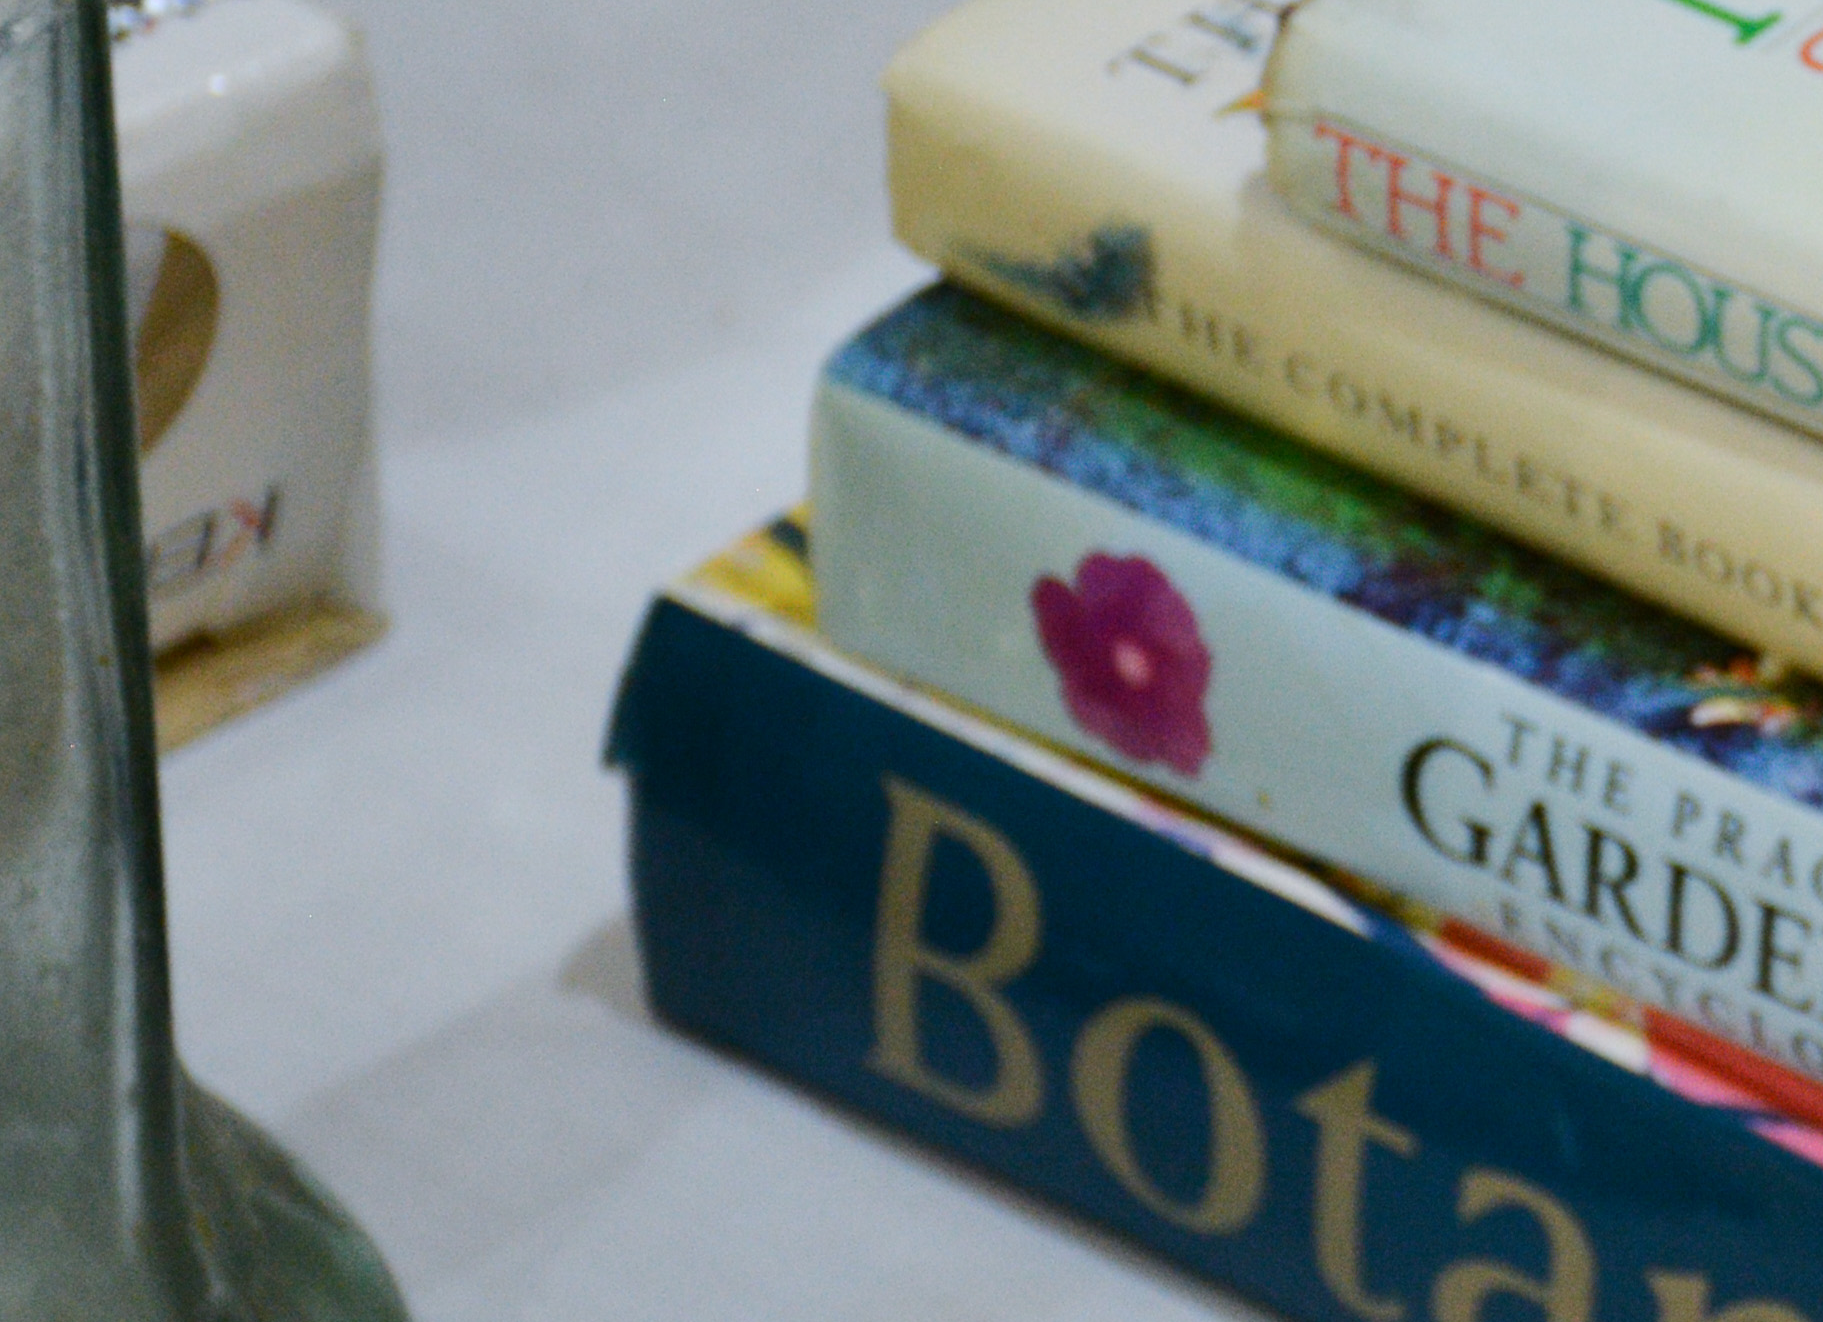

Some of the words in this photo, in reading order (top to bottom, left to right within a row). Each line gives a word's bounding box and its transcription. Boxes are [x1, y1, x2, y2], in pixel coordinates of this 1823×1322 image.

[1315, 123, 1526, 289] THE
[1285, 347, 1627, 539] COMPLETE
[1501, 712, 1634, 815] THE
